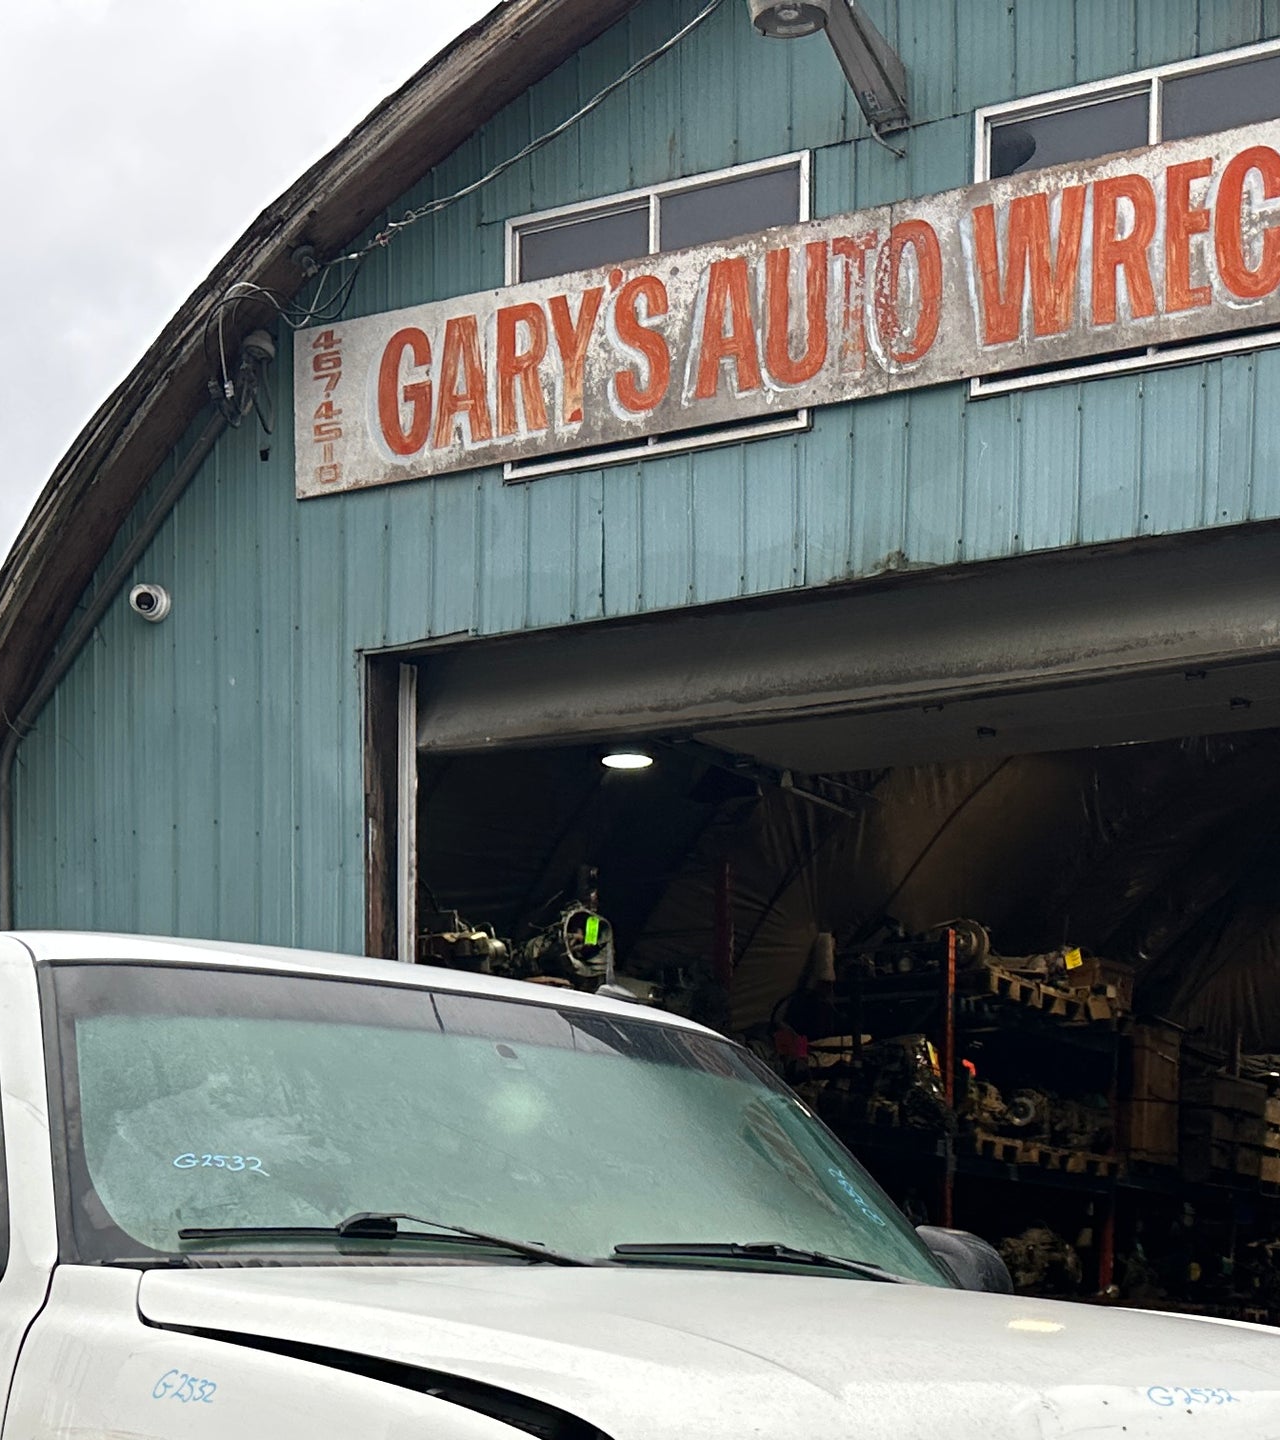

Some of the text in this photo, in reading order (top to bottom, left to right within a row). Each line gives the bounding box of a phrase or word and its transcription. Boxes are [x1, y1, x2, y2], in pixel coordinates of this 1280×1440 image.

[376, 268, 671, 456] GARY'S
[693, 218, 943, 400] AUTO
[172, 1152, 270, 1178] G2532
[152, 1368, 217, 1404] G2532
